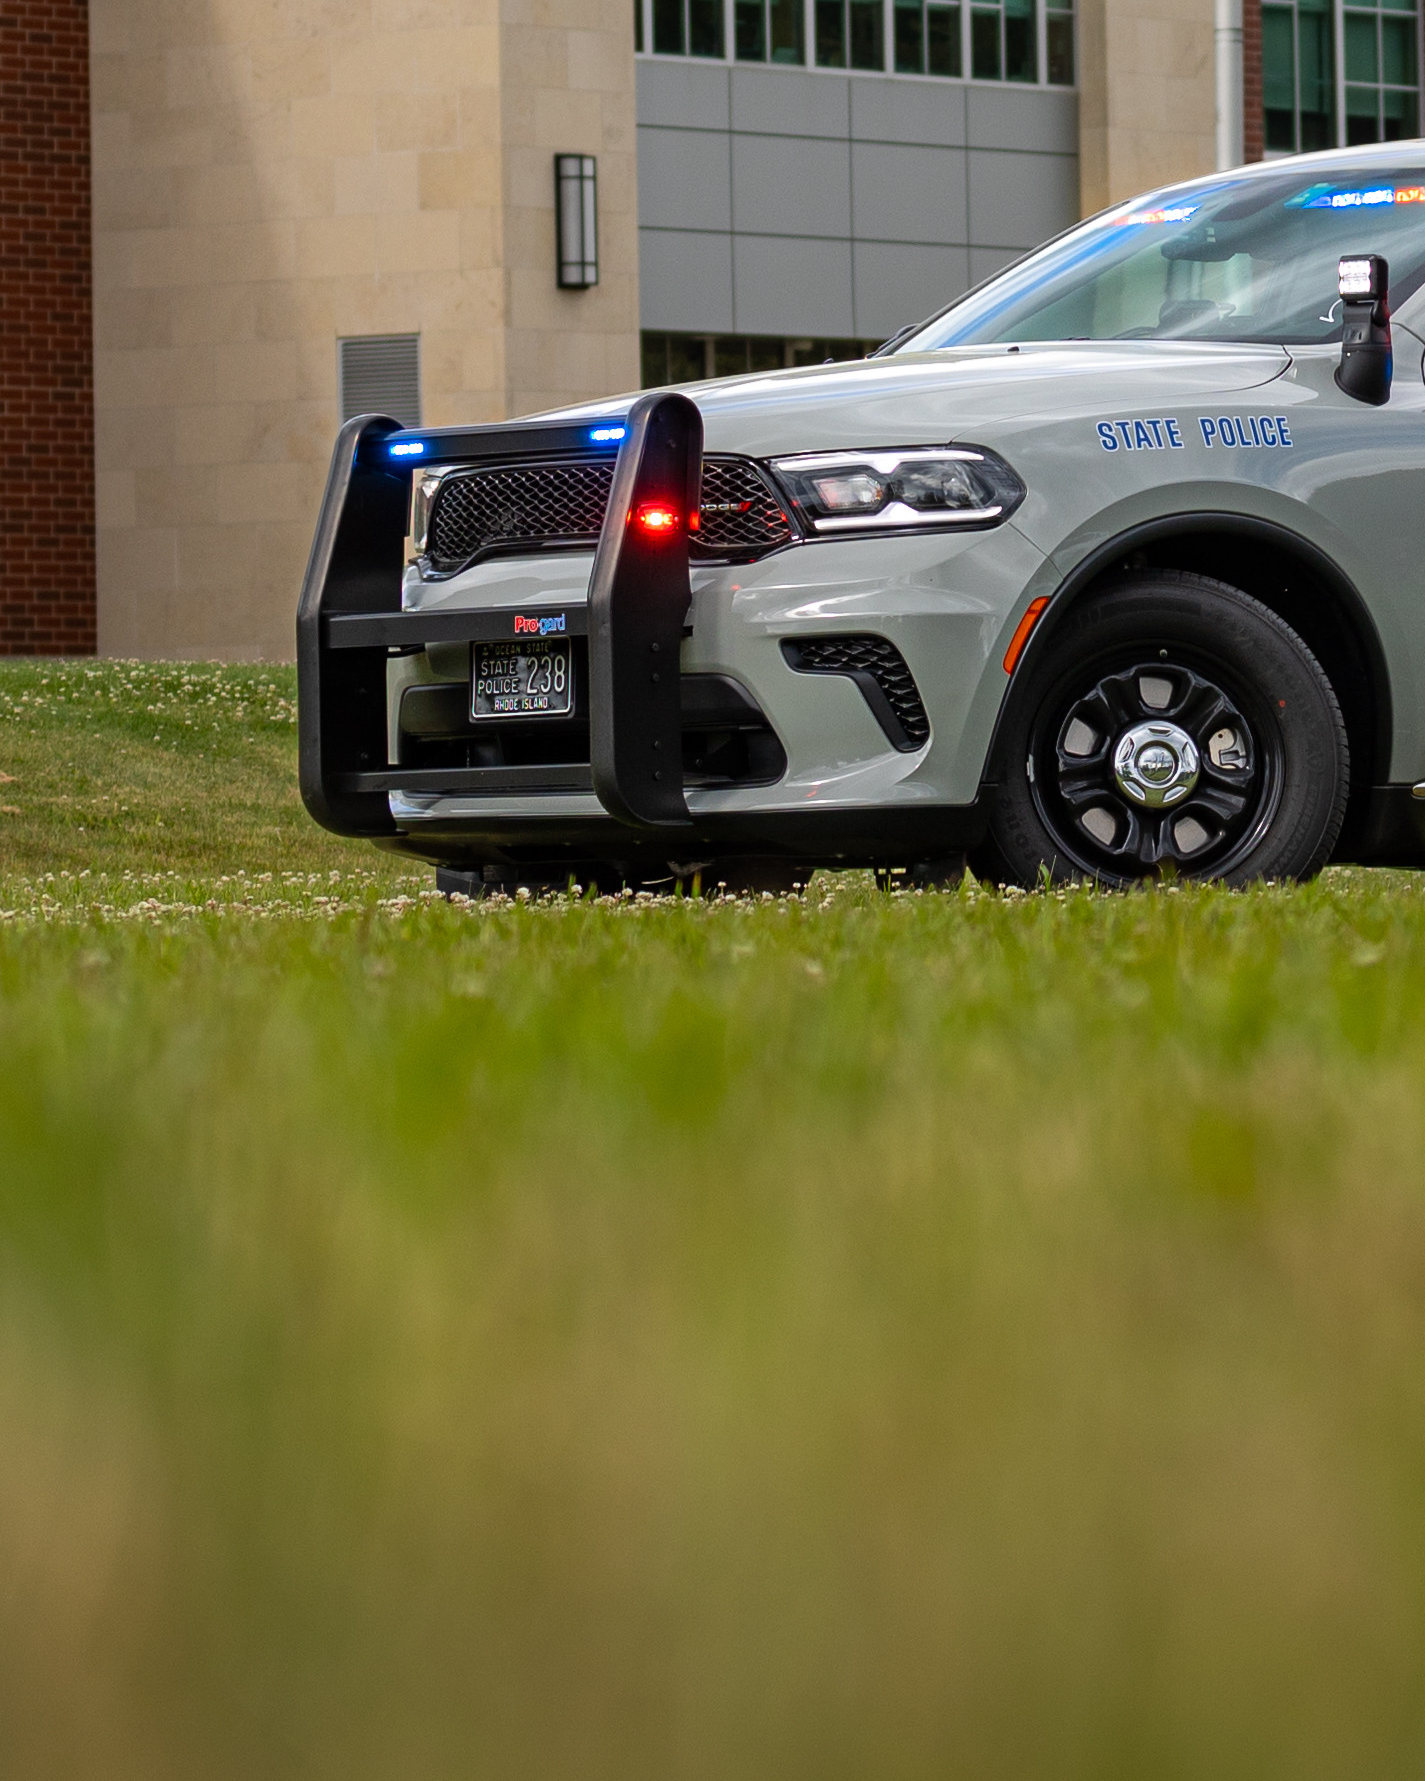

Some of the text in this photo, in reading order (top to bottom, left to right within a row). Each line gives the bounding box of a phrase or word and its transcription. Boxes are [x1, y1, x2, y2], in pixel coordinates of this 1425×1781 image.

[1096, 416, 1293, 452] STATE POLICE
[481, 659, 517, 676] STATE
[527, 655, 565, 693] 238
[478, 678, 519, 694] POLICE
[494, 697, 548, 711] RHODE ISLAND
